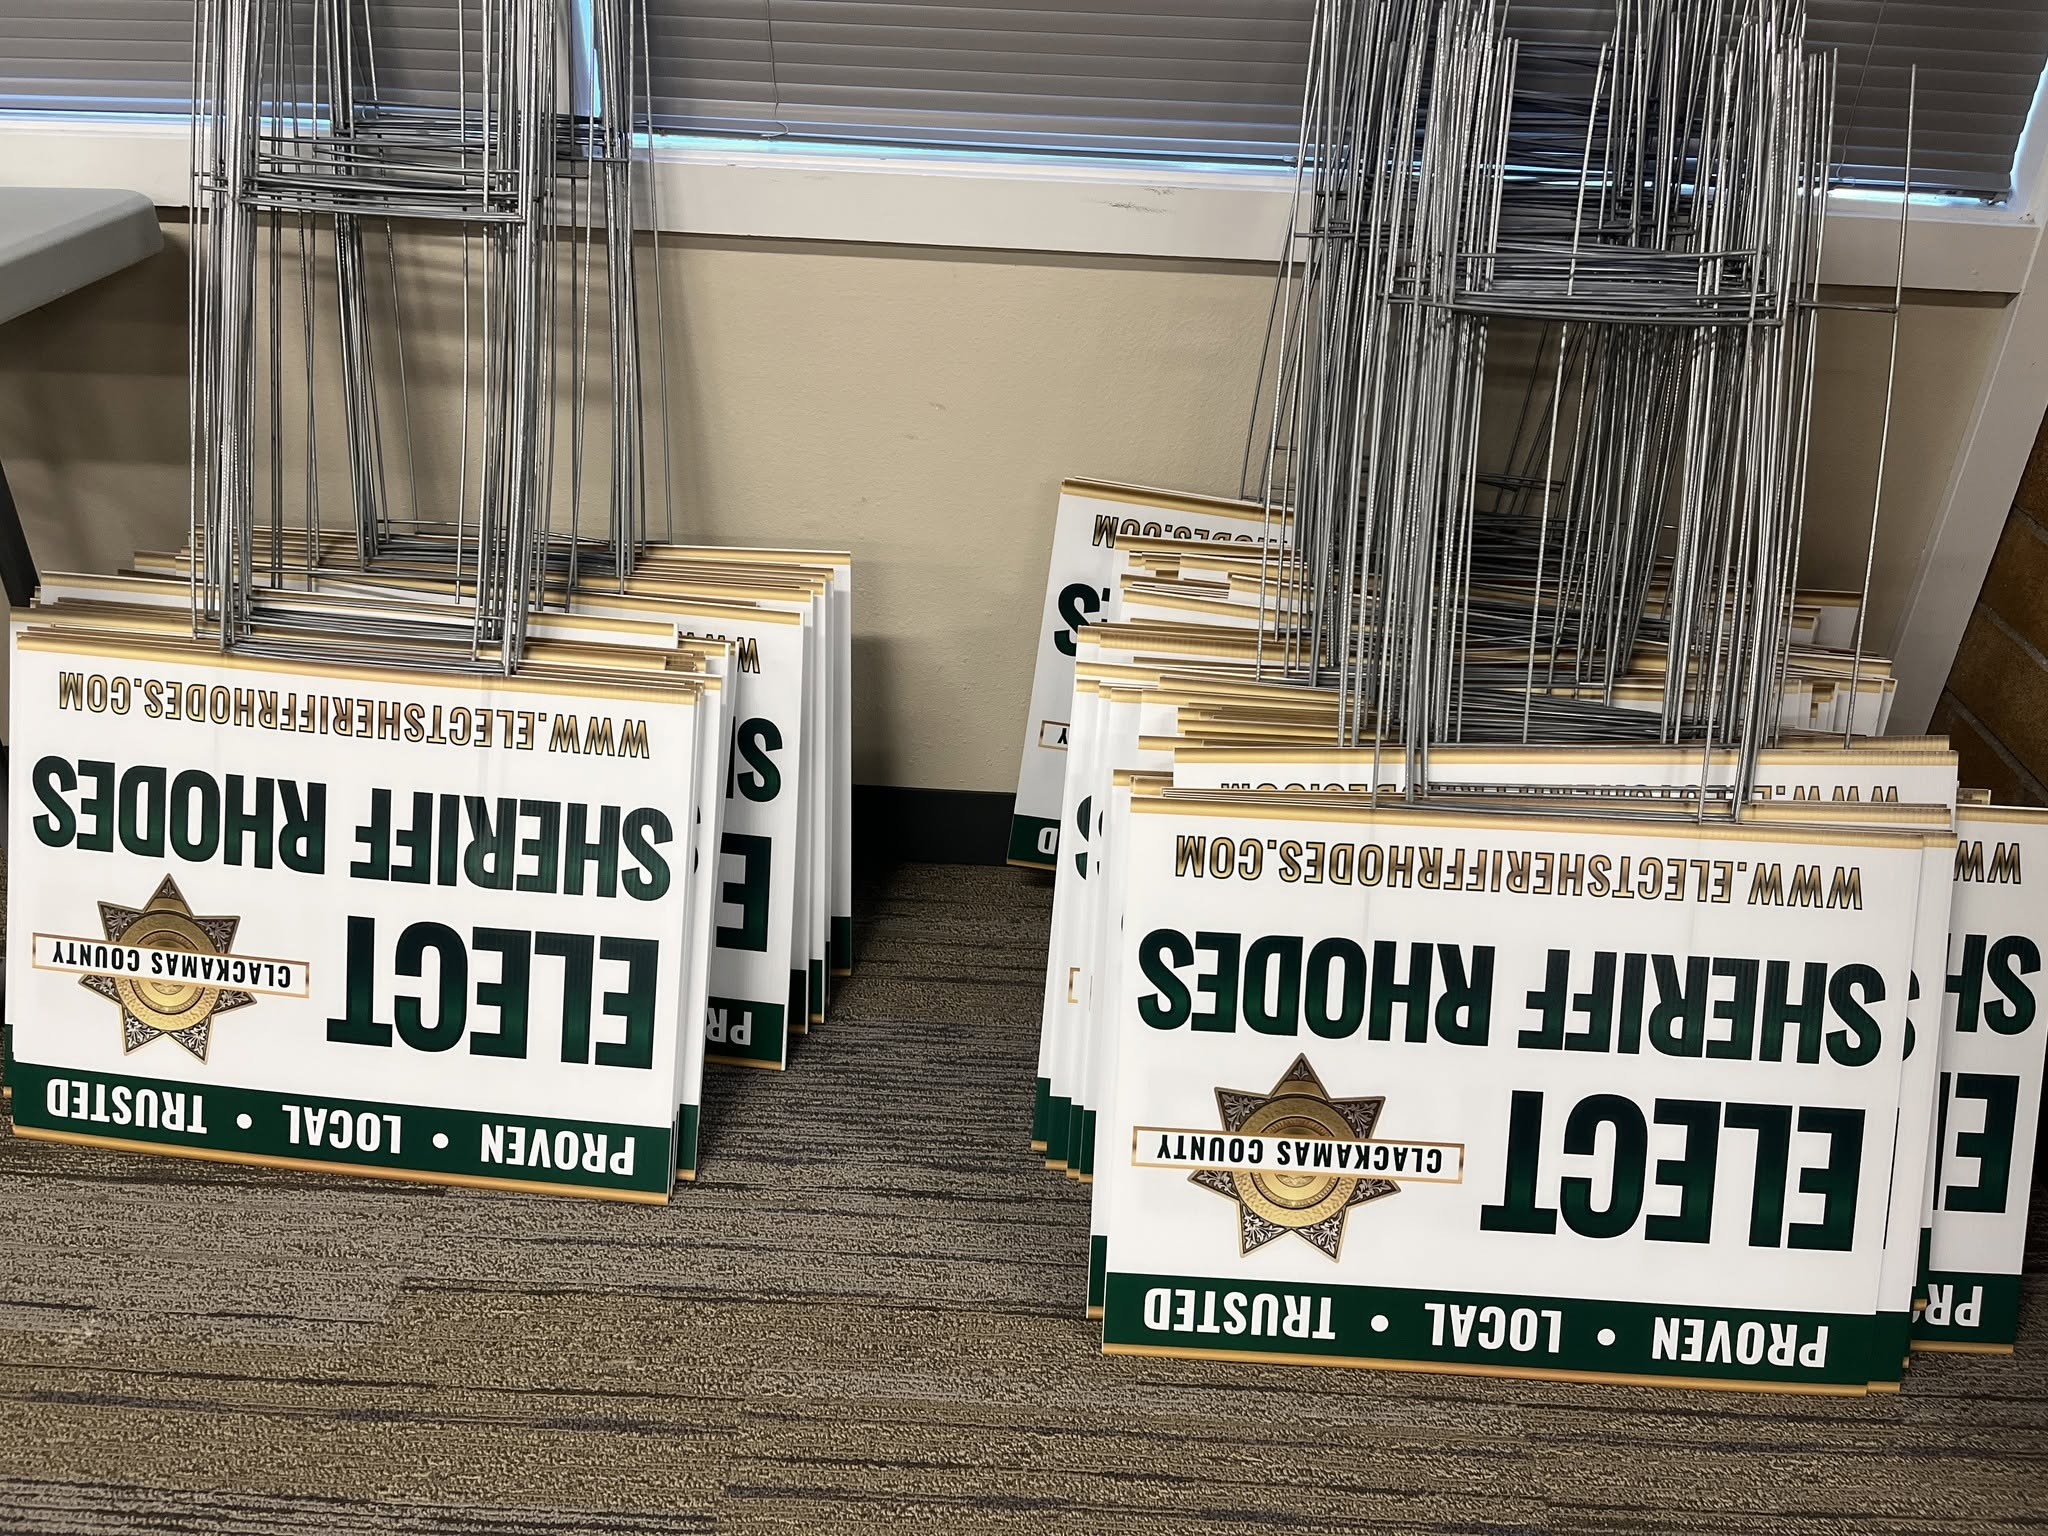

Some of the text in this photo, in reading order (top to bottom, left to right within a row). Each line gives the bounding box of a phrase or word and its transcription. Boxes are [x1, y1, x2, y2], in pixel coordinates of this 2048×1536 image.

[59, 671, 650, 760] WWW.ELECTSHERIFFRHODES.COM
[32, 755, 327, 875] RHODES
[349, 787, 673, 902] SHERIFF
[1175, 834, 1863, 911] WWW.ELECTSHERIFFRHODES.COM
[52, 941, 291, 988] CLACKAMAS COUNTY
[326, 915, 660, 1070] ELECT
[1137, 928, 1496, 1047] RHODES
[1517, 948, 1886, 1067] SHERIFF
[46, 1078, 635, 1176] PROVEN LOCAL TRUSTED
[1157, 1134, 1442, 1174] CLACKAMAS COUNTY
[1479, 1089, 1866, 1252] ELECT
[1143, 1287, 1829, 1368] PROVEN LOCAL TRUSTED
